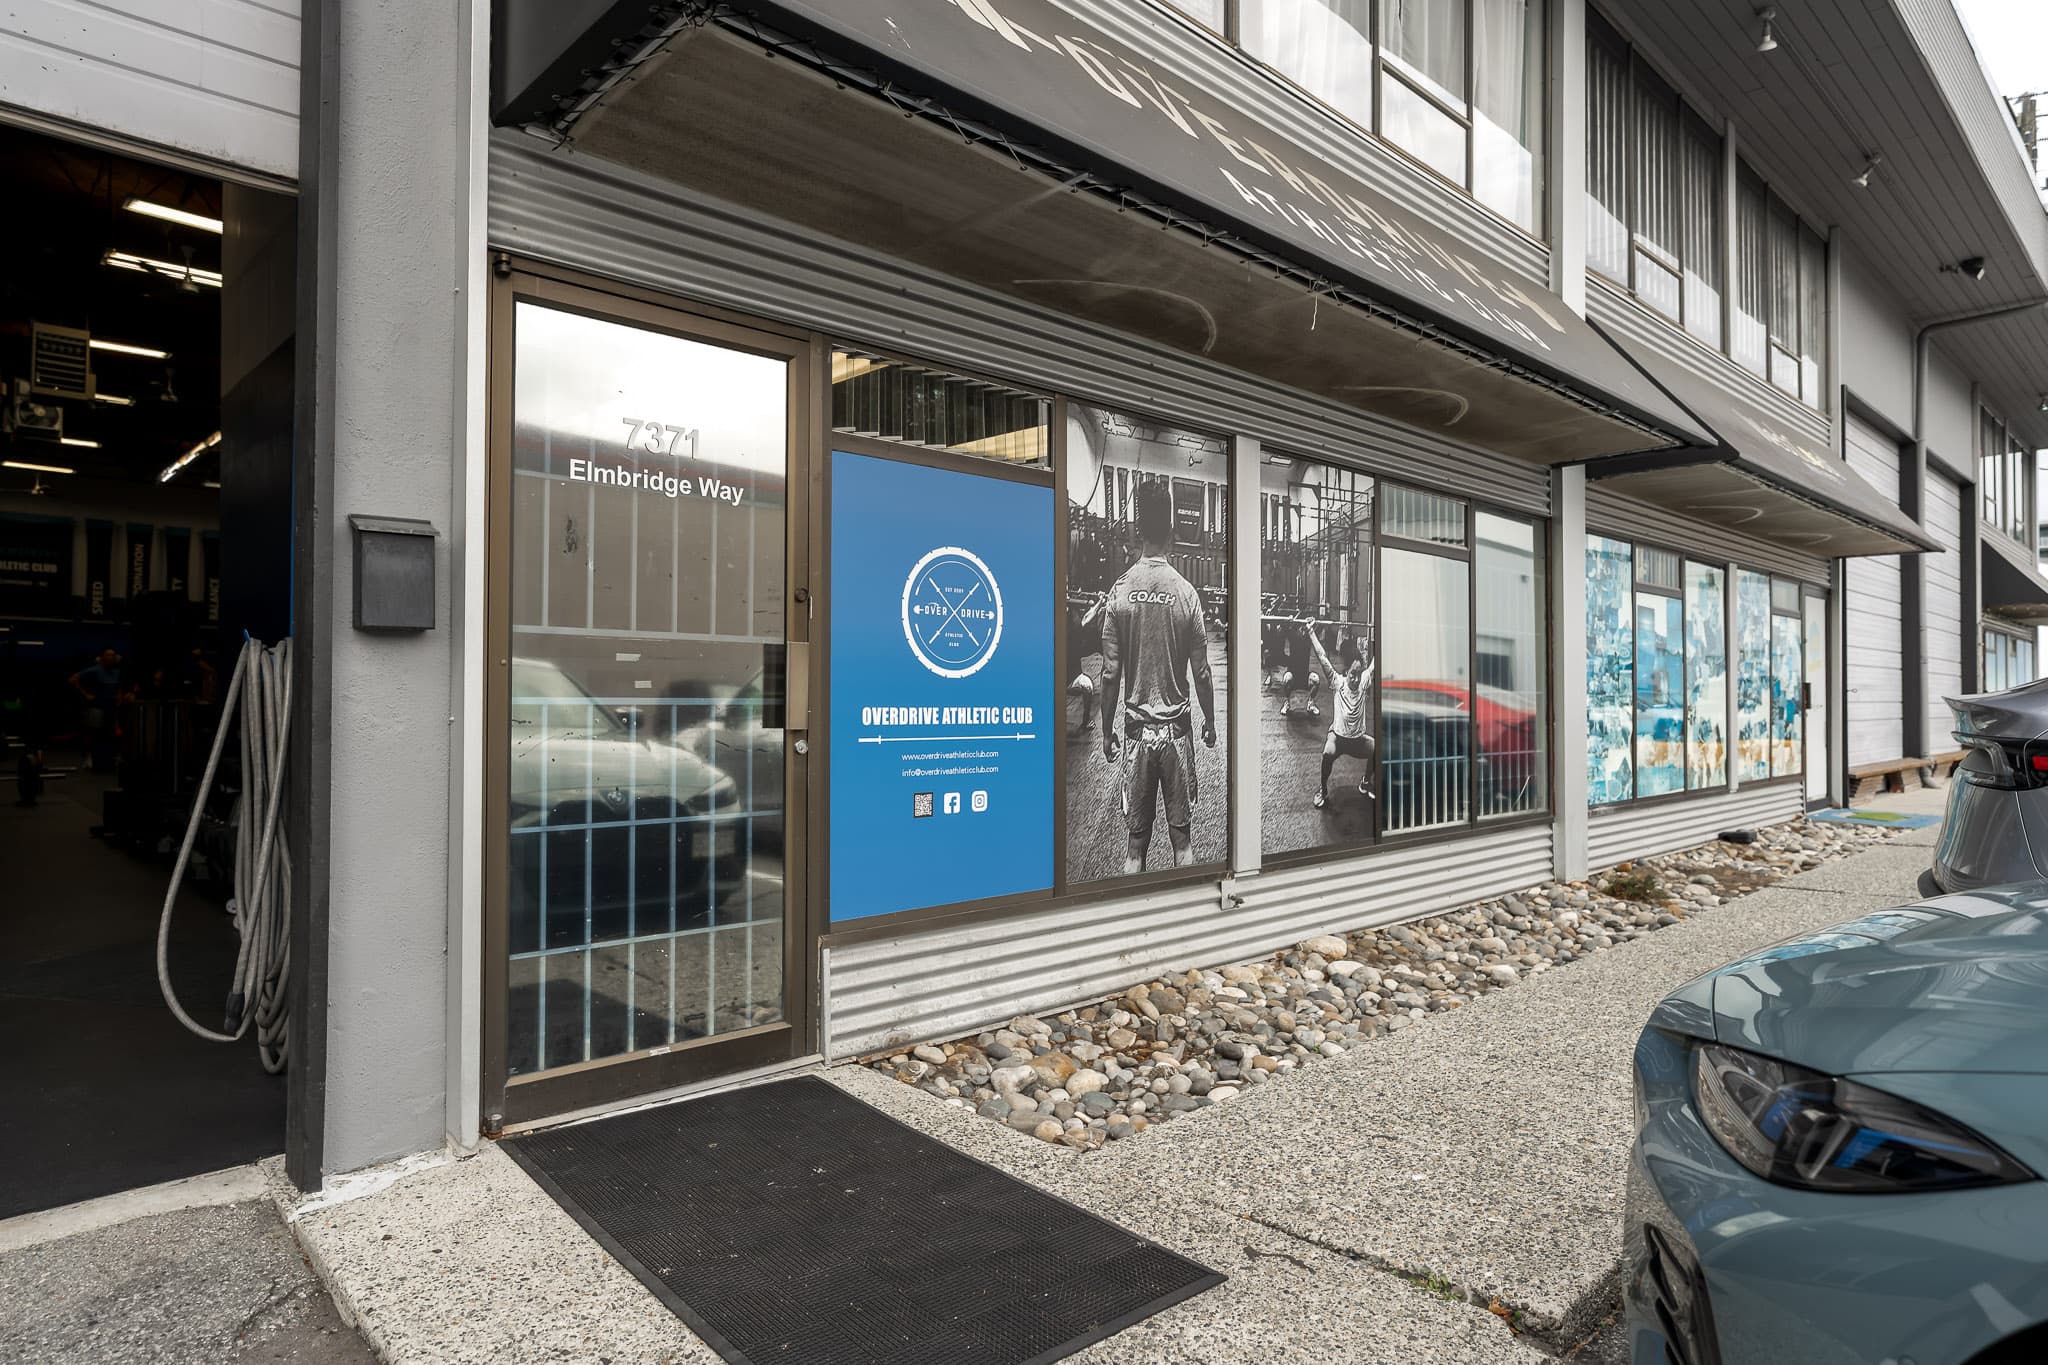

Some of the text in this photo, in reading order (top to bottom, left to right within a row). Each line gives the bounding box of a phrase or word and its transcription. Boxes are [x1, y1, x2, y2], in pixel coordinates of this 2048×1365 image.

[1055, 35, 1522, 309] OVERDRIVE
[1219, 167, 1551, 350] ATHLETIC CLUB
[622, 417, 700, 459] 7371
[569, 458, 744, 506] Elmbridge Way
[92, 581, 104, 615] SPEED
[924, 605, 985, 618] OVER DRIVE
[1129, 591, 1176, 605] COACH
[862, 706, 1033, 726] OVERDRIVE ATHLETIC CLUB
[901, 750, 999, 761] www.overdriveathleticclub.com
[901, 765, 999, 777] info@overdriveathleticclub.com
